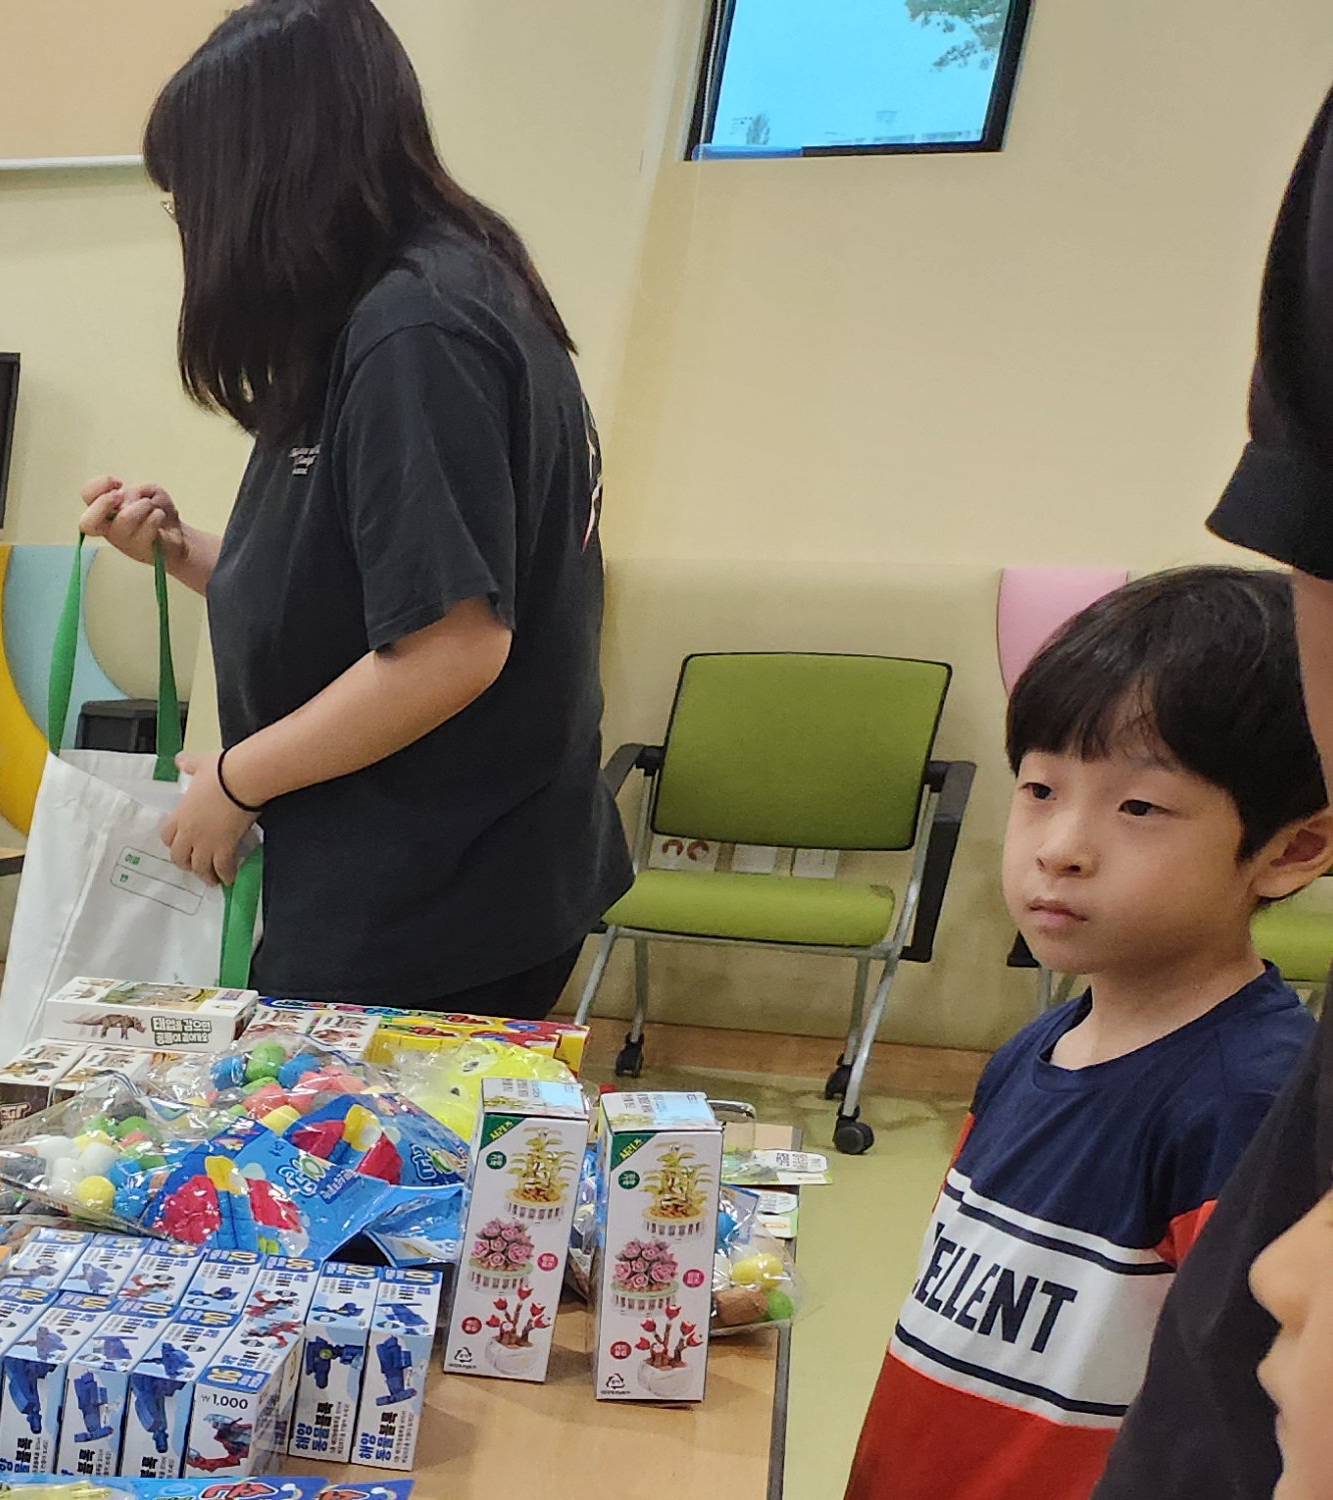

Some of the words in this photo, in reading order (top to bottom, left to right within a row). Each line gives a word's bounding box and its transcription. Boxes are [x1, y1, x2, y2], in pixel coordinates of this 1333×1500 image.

[619, 1137, 644, 1161] 시리즈
[912, 1222, 1078, 1354] ELLENT
[295, 1422, 313, 1450] 해양
[359, 1432, 377, 1460] 해양
